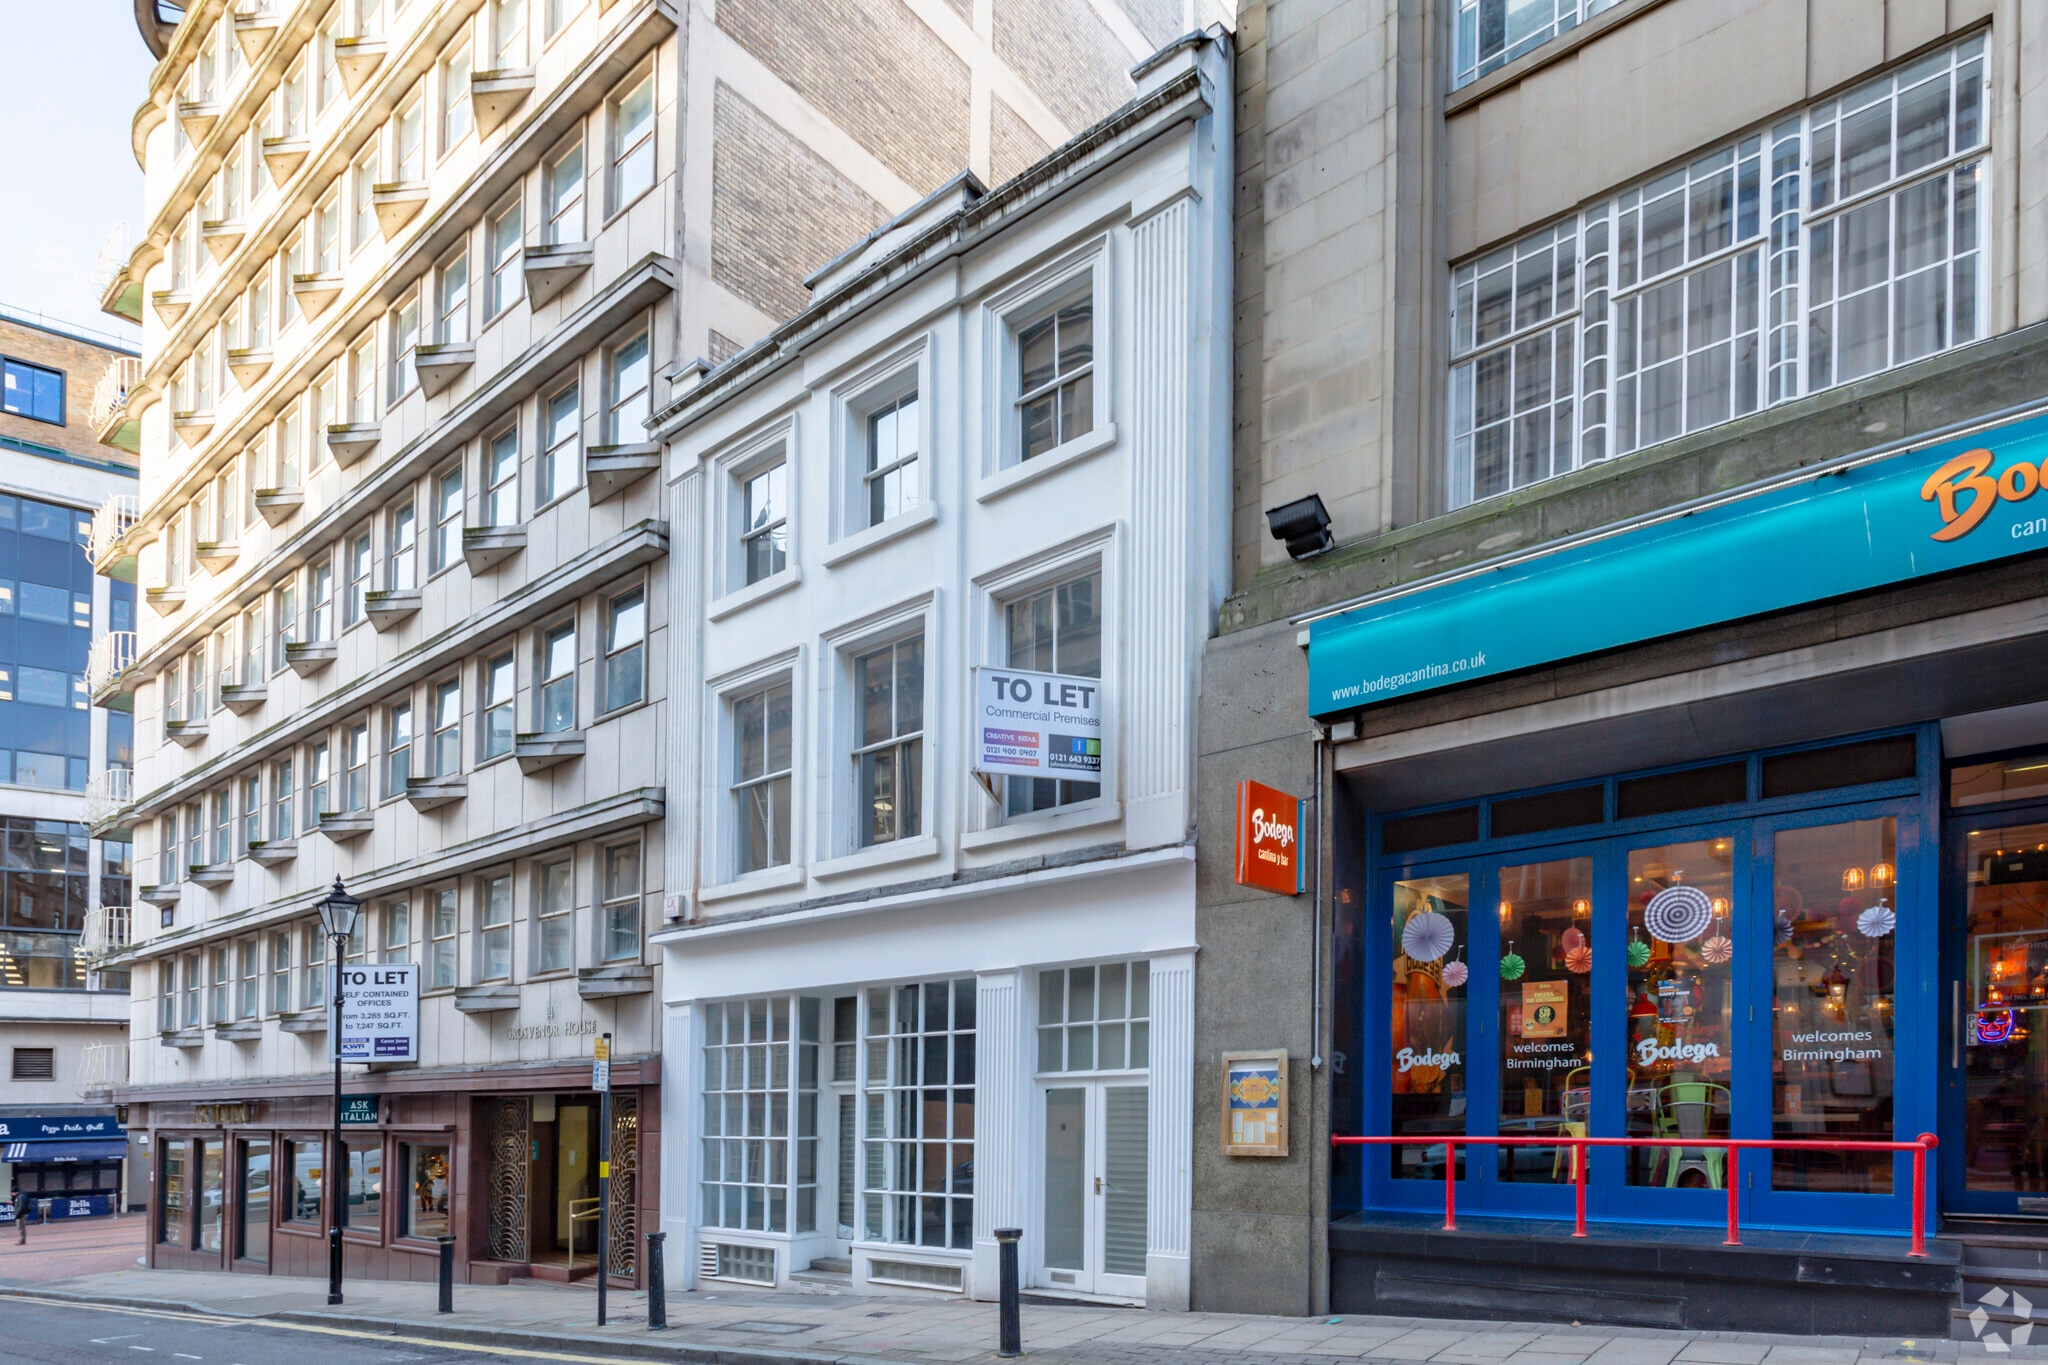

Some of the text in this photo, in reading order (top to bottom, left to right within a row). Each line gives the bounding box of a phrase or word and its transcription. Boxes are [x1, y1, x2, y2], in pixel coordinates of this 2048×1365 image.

[1921, 448, 2048, 543] Bo
[2011, 518, 2047, 539] can
[1331, 651, 1486, 700] www.bodegacantina.co.uk
[991, 675, 1096, 709] TO LET
[985, 705, 1100, 727] Commercial Premises
[985, 732, 1036, 743] CREATIVE RETAIL
[985, 746, 1037, 757] 0121 400 0407
[1049, 753, 1100, 765] 0121 643 9337
[1251, 807, 1295, 848] Bodega
[1258, 848, 1289, 866] cantina y bar
[342, 971, 409, 985] TO LET
[362, 990, 409, 998] CONTAINED
[357, 999, 392, 1007] OFFICES
[360, 1012, 381, 1020] 3,285
[383, 1011, 410, 1019] SQ.FT.
[356, 1022, 375, 1030] 7,247
[377, 1021, 404, 1029] SQ.FT.
[506, 1019, 597, 1040] GROSVENOR HOUSE
[1967, 1015, 1975, 1045] PULL
[1791, 1030, 1873, 1043] welcomes
[1513, 1042, 1575, 1053] welcomes
[1636, 1037, 1720, 1067] Bodega
[1396, 1047, 1462, 1073] Bodega
[1783, 1047, 1882, 1063] Birmingham
[1506, 1057, 1582, 1071] Birmingham
[350, 1101, 369, 1110] ASK
[340, 1112, 377, 1122] ITALIAN
[41, 1124, 61, 1134] Pizza
[63, 1123, 83, 1132] Pasta
[86, 1123, 104, 1132] Grill
[0, 1204, 15, 1213] Bell
[69, 1200, 91, 1208] Bella
[69, 1208, 91, 1216] Italia
